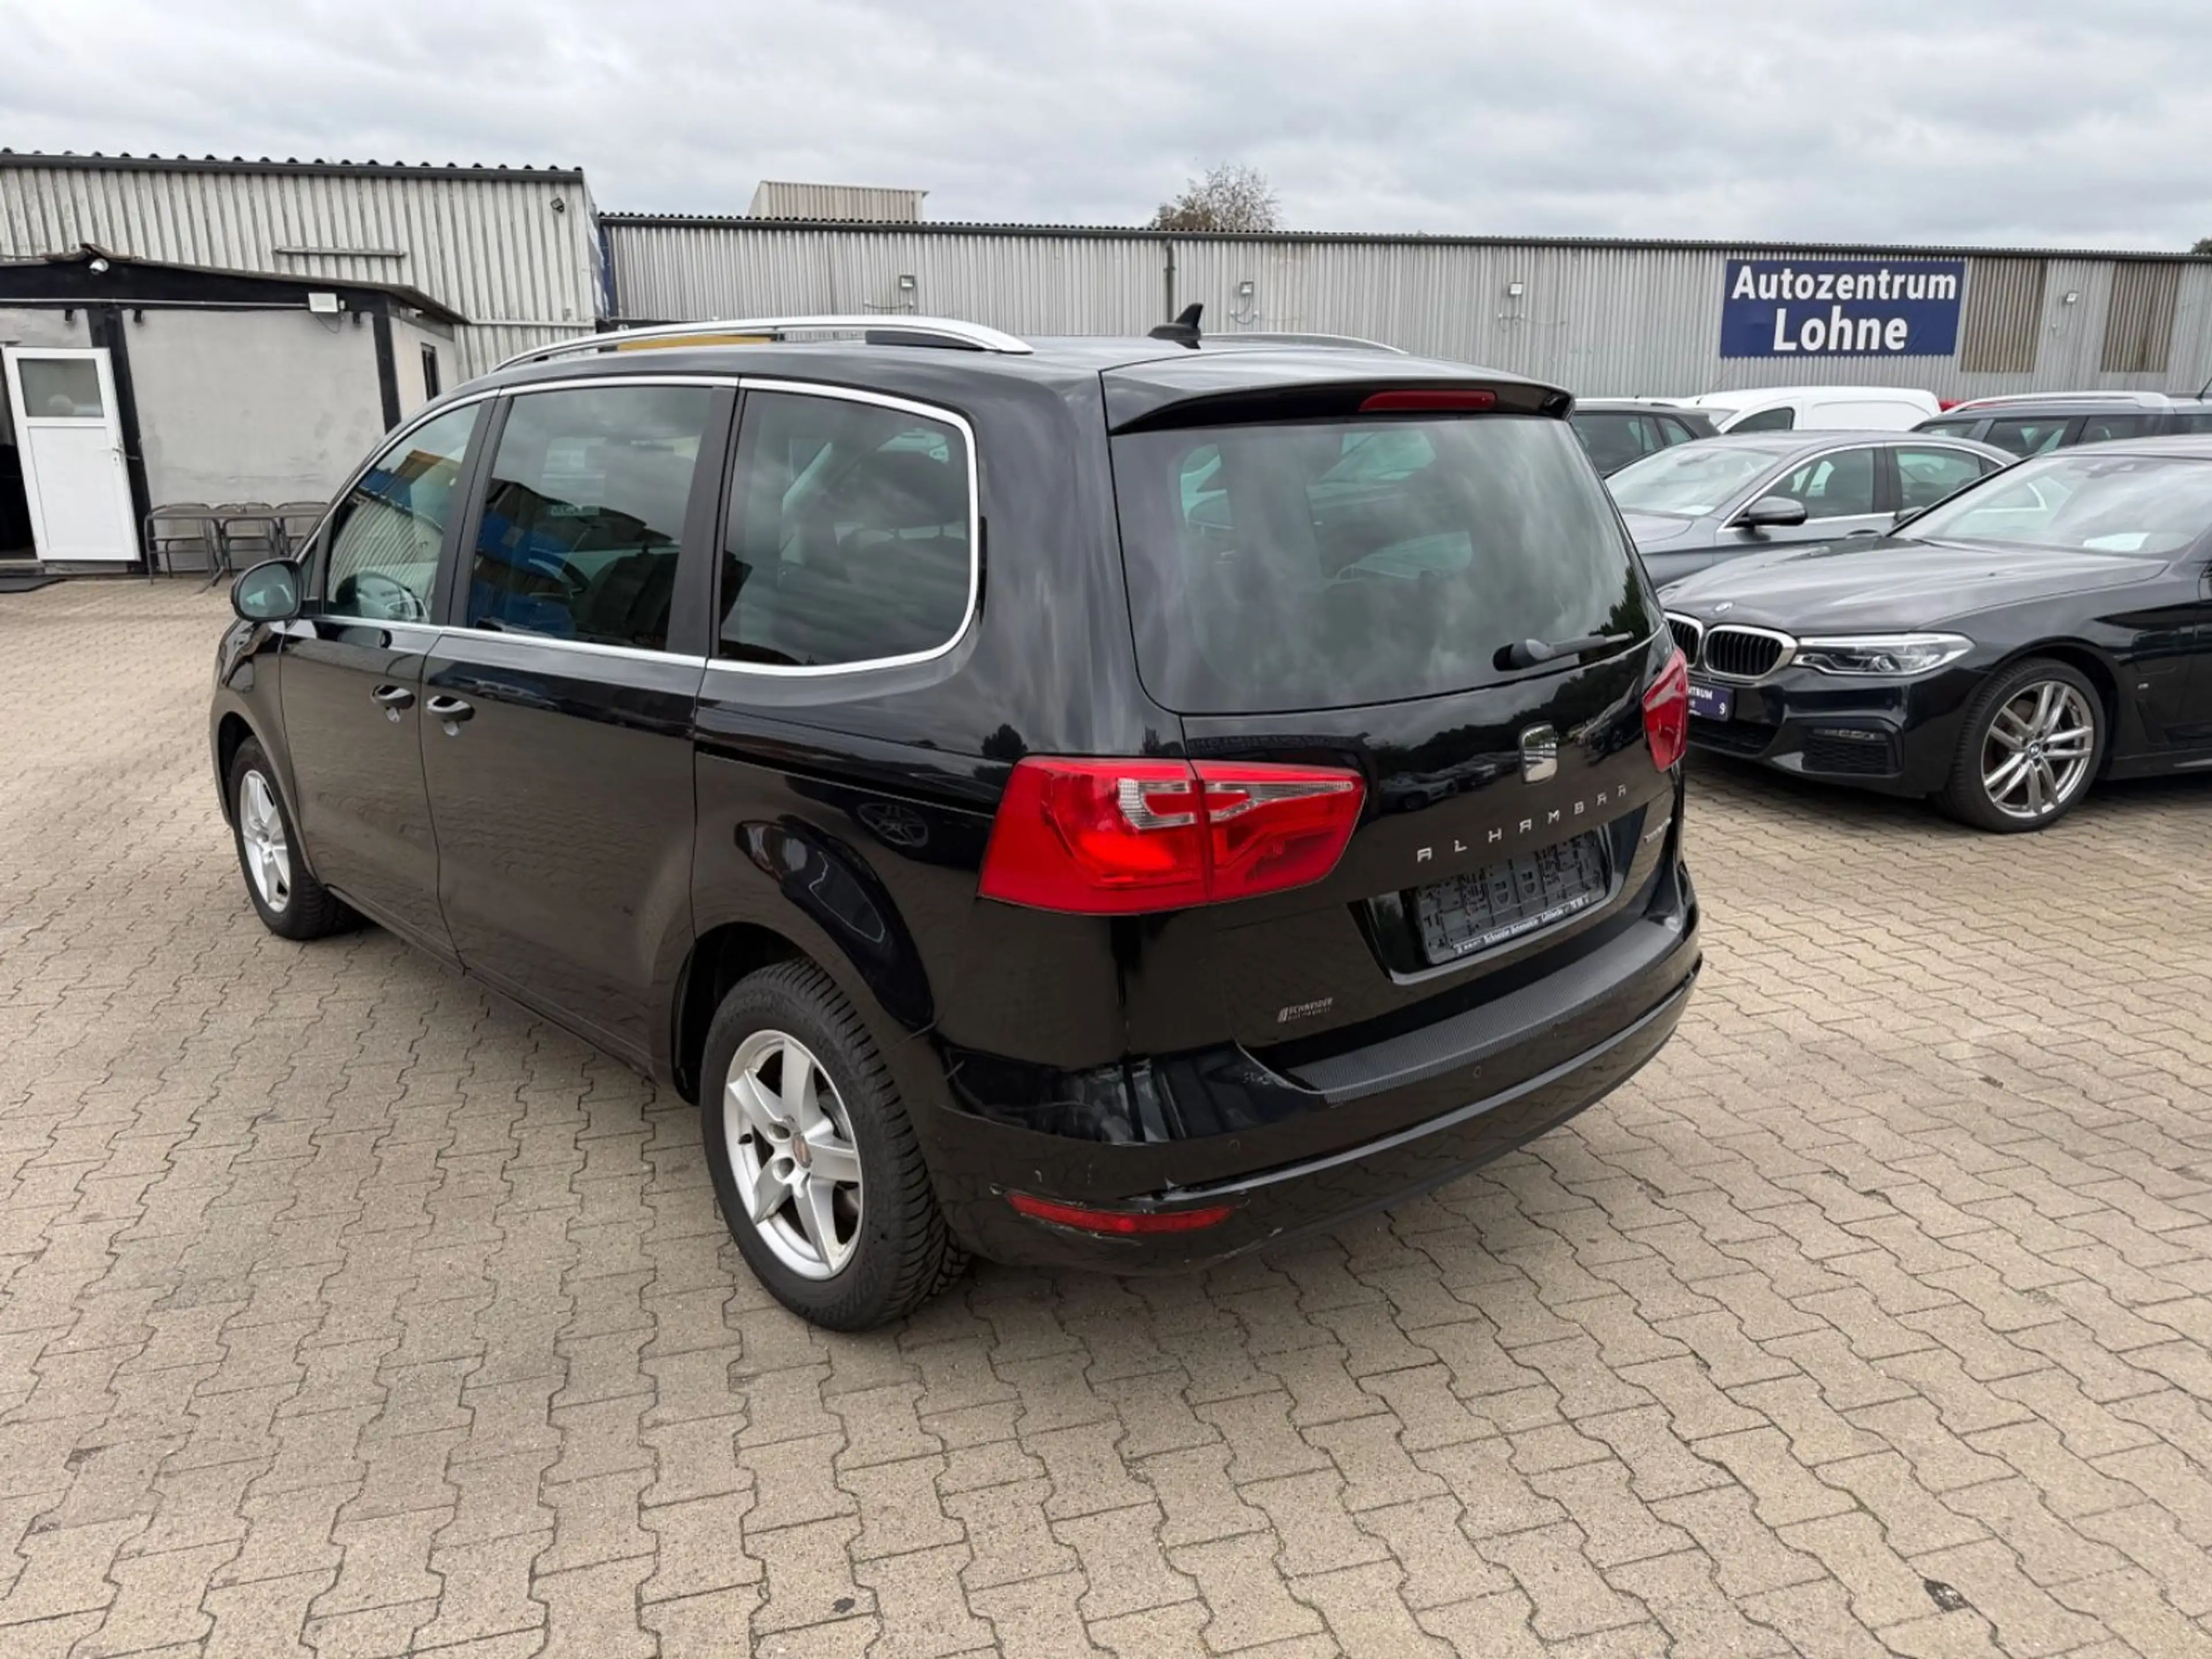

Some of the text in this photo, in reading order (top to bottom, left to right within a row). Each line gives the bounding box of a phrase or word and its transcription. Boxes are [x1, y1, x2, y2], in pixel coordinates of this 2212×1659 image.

[1732, 265, 1956, 300] Autozentrum
[1773, 305, 1908, 351] Lohne
[1416, 784, 1627, 862] ALHAMBRA
